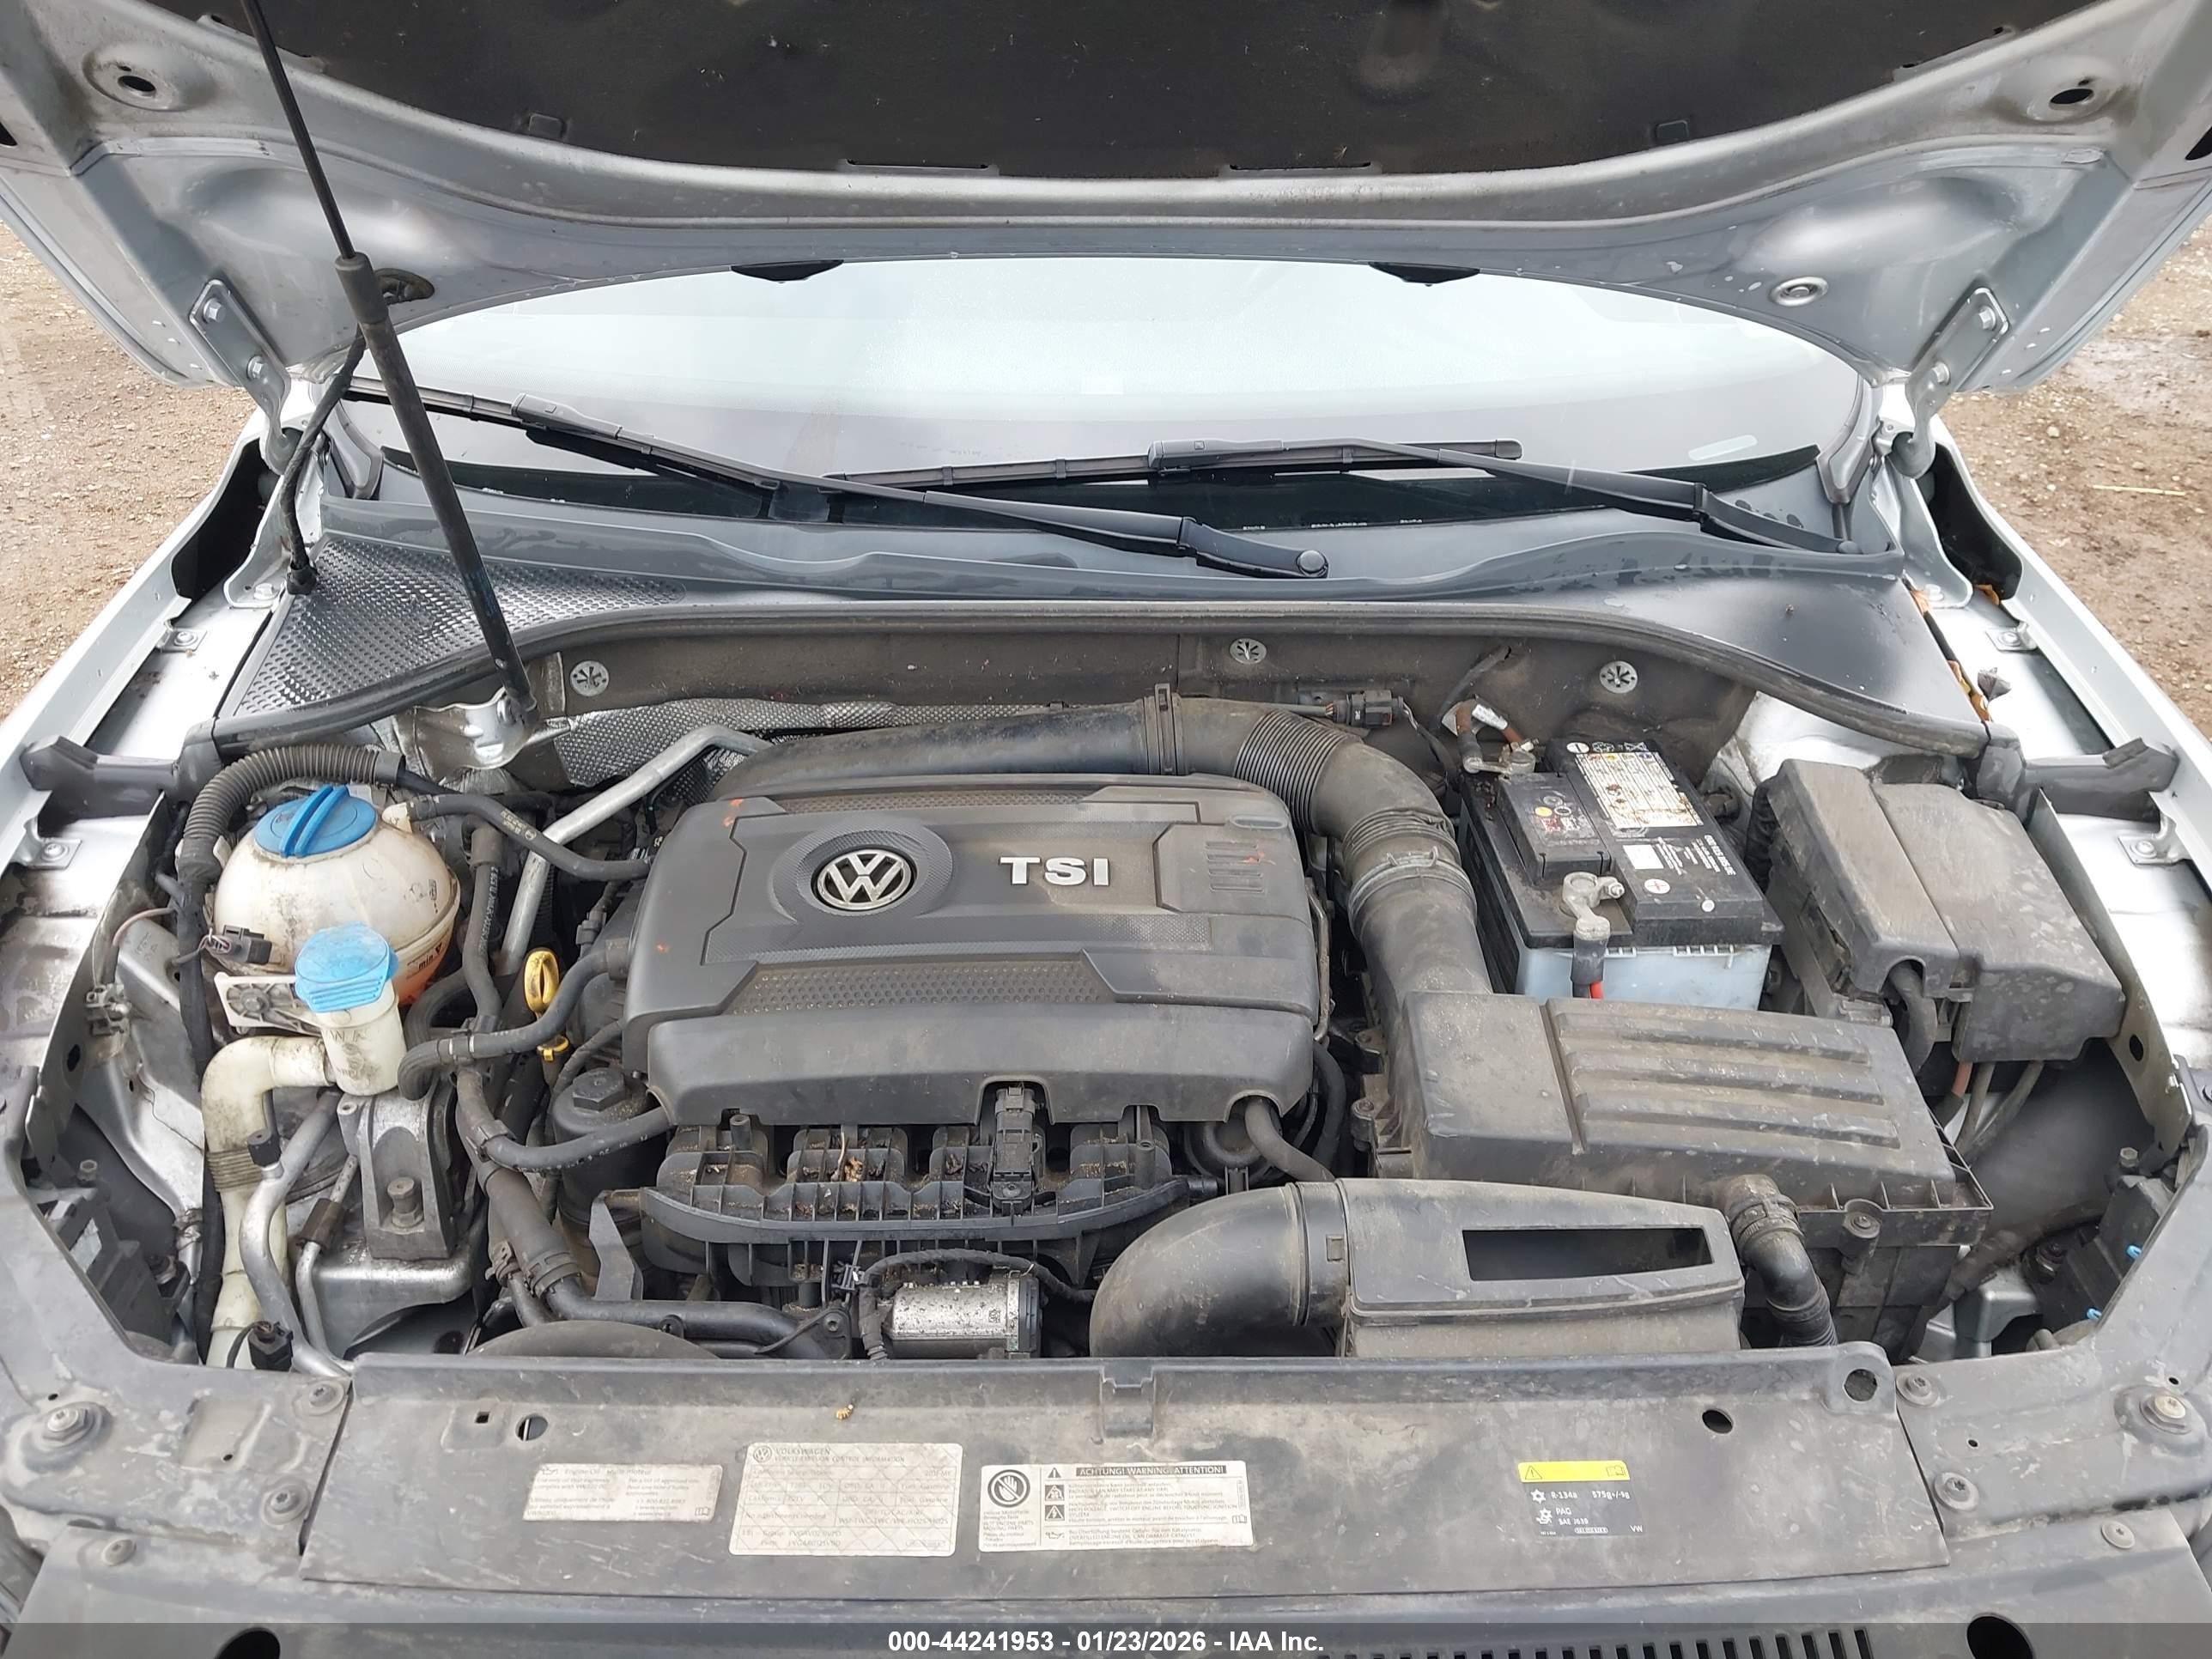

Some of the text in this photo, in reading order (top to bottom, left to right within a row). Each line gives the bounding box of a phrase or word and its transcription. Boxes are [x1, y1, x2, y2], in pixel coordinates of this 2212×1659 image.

[999, 856, 1110, 886] TSI
[418, 954, 434, 970] min
[775, 1447, 831, 1455] VOLKSWAGEN
[1079, 1468, 1125, 1477] ACHTUNG!
[1174, 1465, 1224, 1475] ATTENTION!
[1555, 1507, 1572, 1516] PAG
[1630, 1524, 1644, 1533] VW
